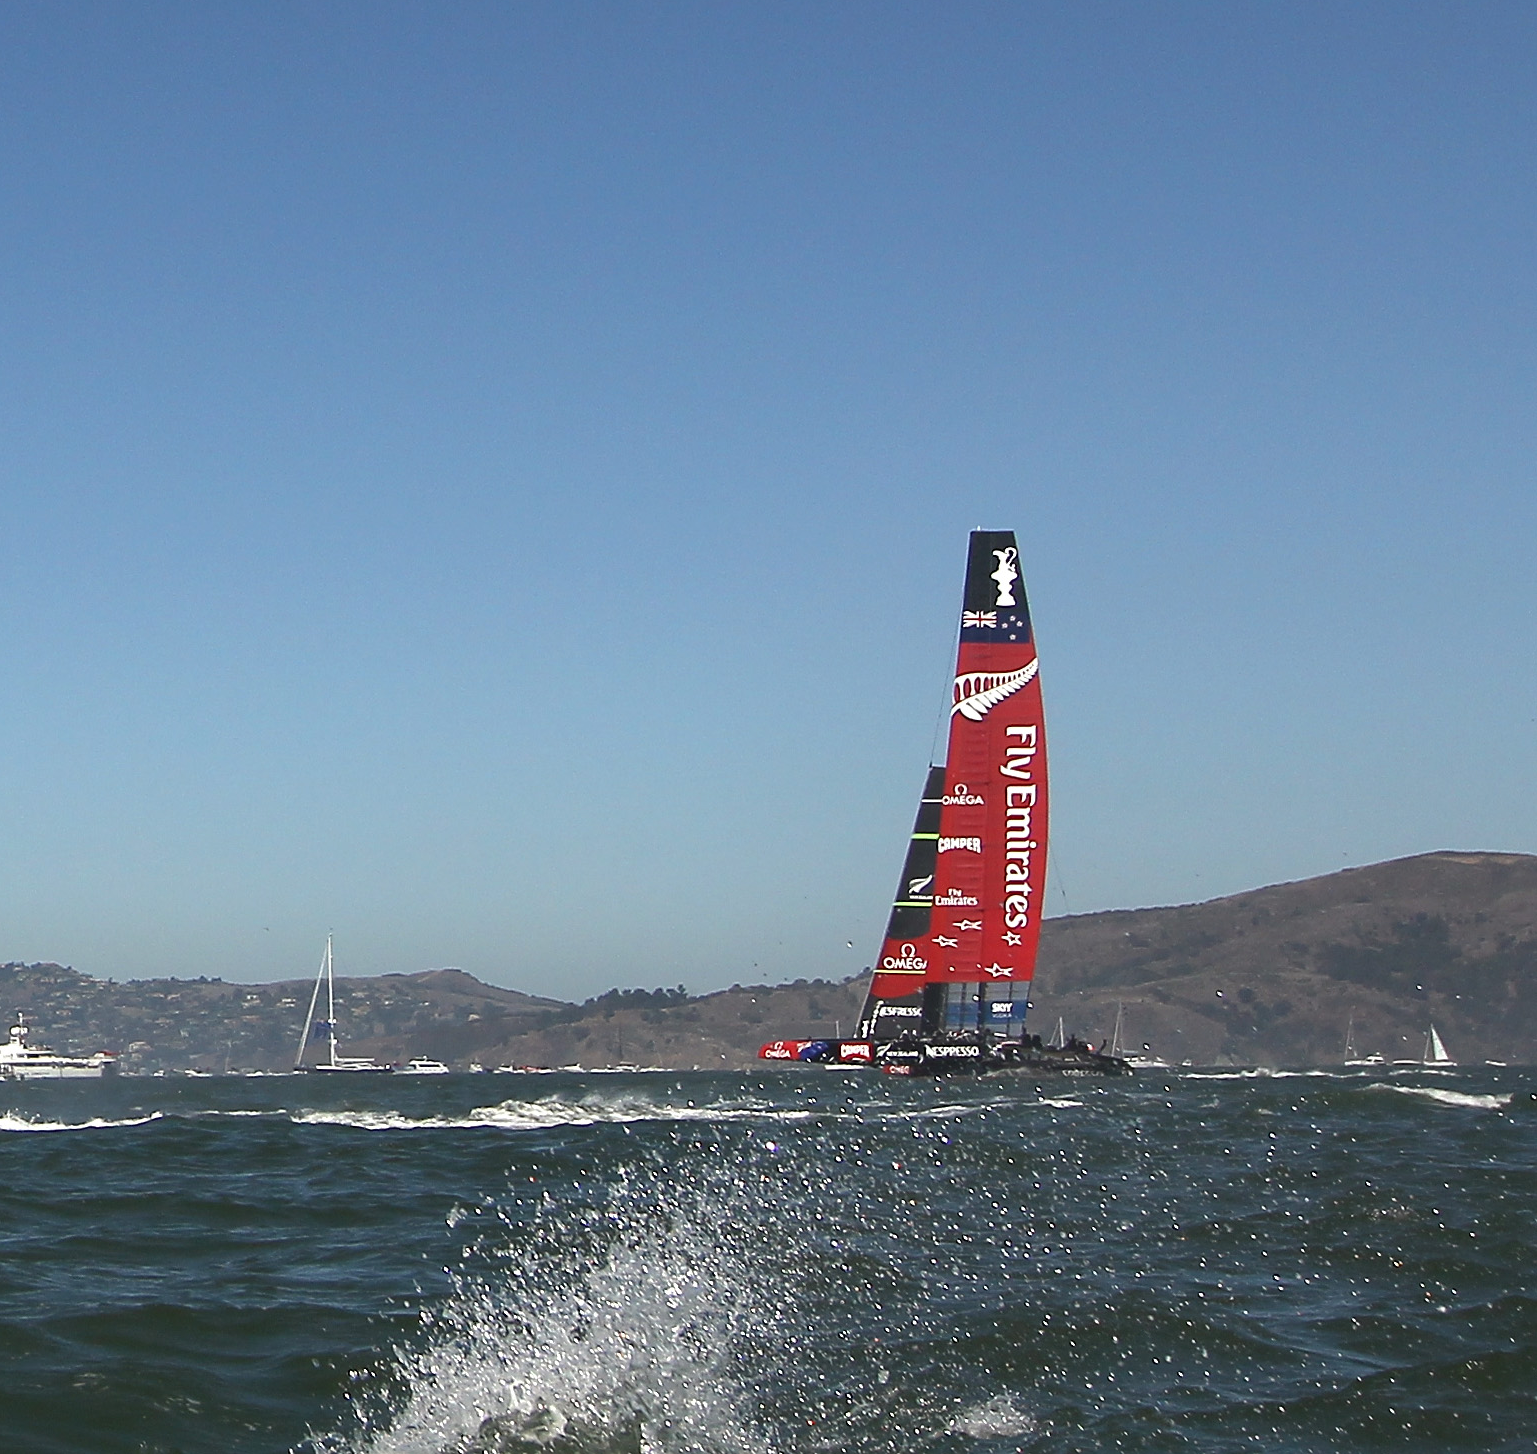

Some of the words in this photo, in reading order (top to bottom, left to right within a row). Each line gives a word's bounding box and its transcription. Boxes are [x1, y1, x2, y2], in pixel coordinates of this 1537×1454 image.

[999, 725, 1037, 780] Fly
[941, 795, 984, 805] OMEGA
[938, 837, 982, 853] CAMPER
[1005, 784, 1037, 928] Emirates
[935, 895, 978, 906] Emirates
